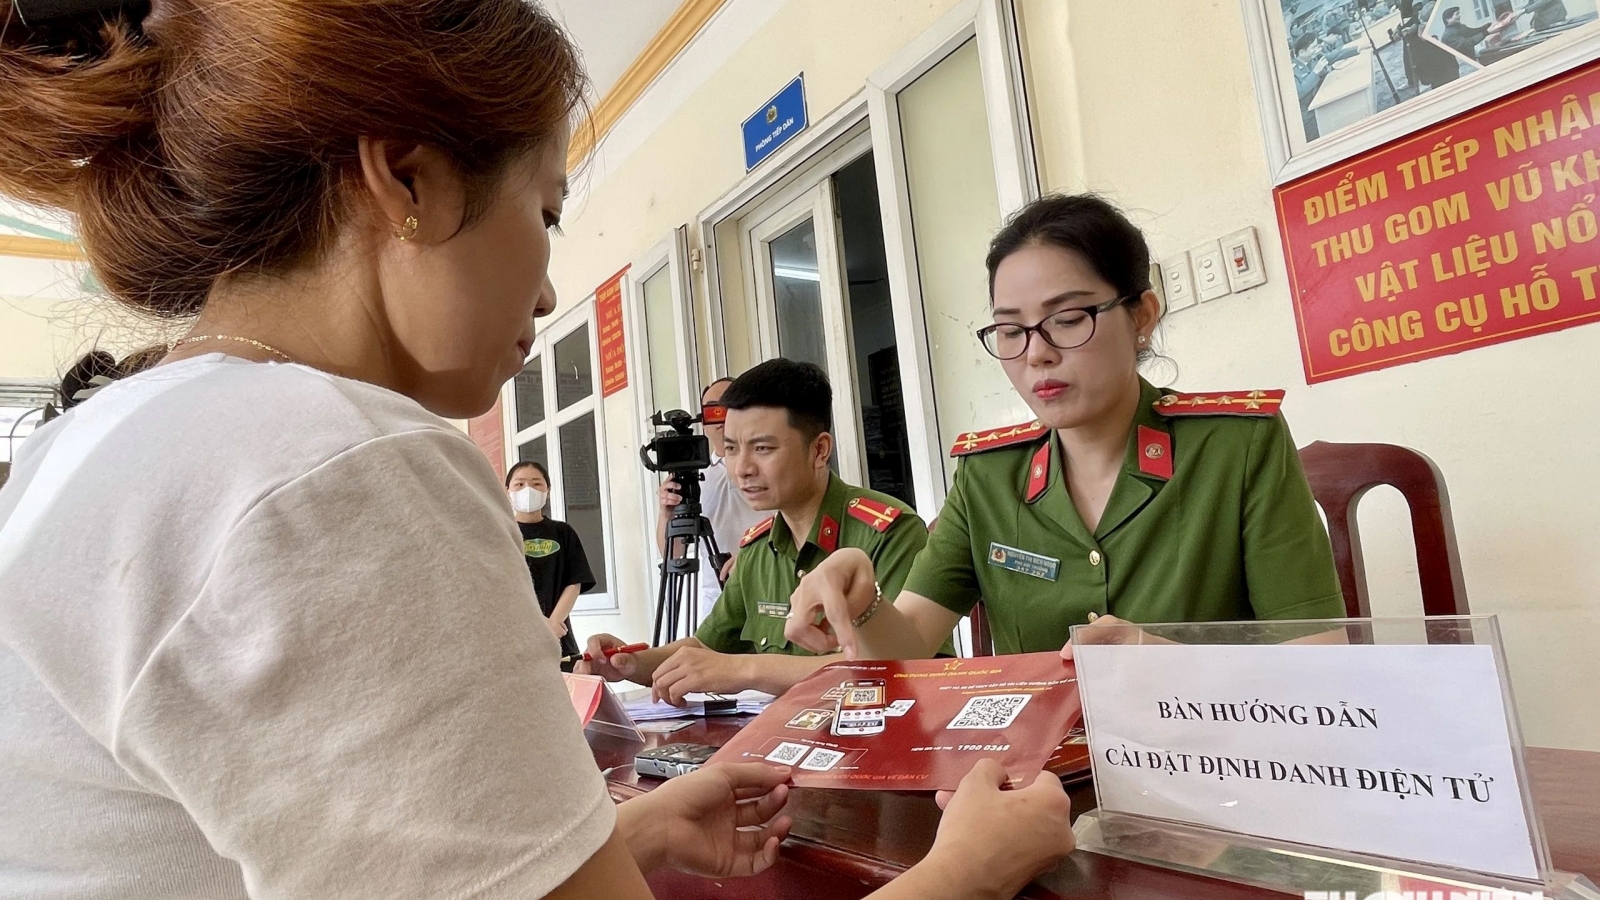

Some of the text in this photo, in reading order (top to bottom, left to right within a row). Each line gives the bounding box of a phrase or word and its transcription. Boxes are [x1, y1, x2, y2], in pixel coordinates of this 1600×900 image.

[755, 117, 794, 152] PHÒNG TIẾP DÂN
[1303, 171, 1388, 225] ĐIỂM
[1397, 136, 1480, 190] TIẾP
[1311, 149, 1600, 268] THU GOM VŨ KH
[1355, 193, 1599, 303] VẬT LIỆU NỔ
[1329, 263, 1600, 357] CÔNG CỤ HỖ T
[1157, 697, 1379, 729] BÀN HƯỚNG DẪN
[1105, 744, 1494, 803] CÀI ĐẶT ĐỊNH DANH ĐIỆN TỬ
